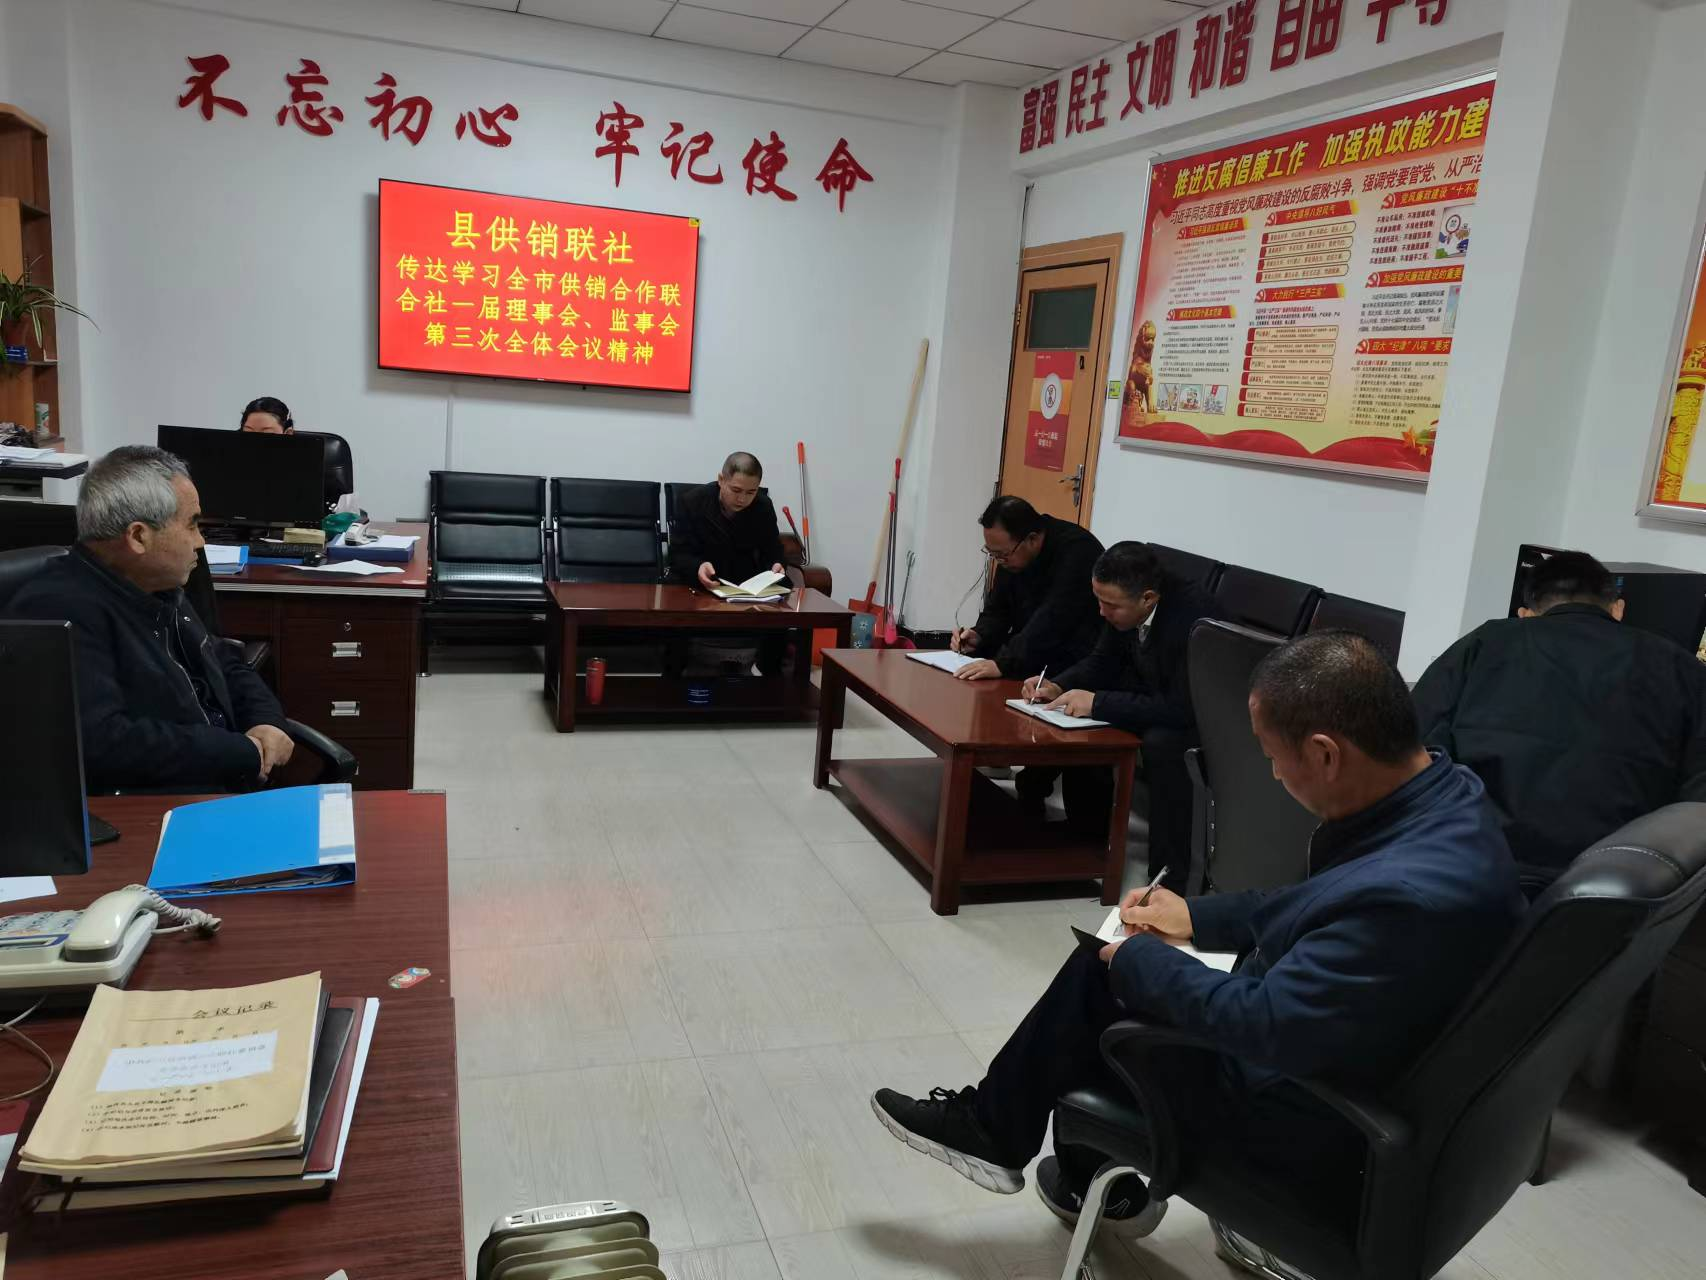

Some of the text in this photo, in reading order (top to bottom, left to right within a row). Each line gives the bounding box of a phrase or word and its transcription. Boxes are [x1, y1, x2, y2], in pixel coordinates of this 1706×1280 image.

[1019, 79, 1060, 154] 富强
[1065, 58, 1112, 139] 民主
[1120, 28, 1179, 120] 文明
[1188, 0, 1257, 99] 和谐
[1270, 0, 1343, 71] 自由
[178, 54, 874, 212] 不忘初心 牢记使命
[1172, 97, 1490, 199] 推进反腐倡廉工作 加强执政能力建
[446, 210, 635, 265] 县供销联社
[395, 253, 682, 307] 传达学习全市供销合作联
[395, 288, 680, 337] 合社一届理事会、监事会
[424, 321, 655, 366] 第三次全体会议精神
